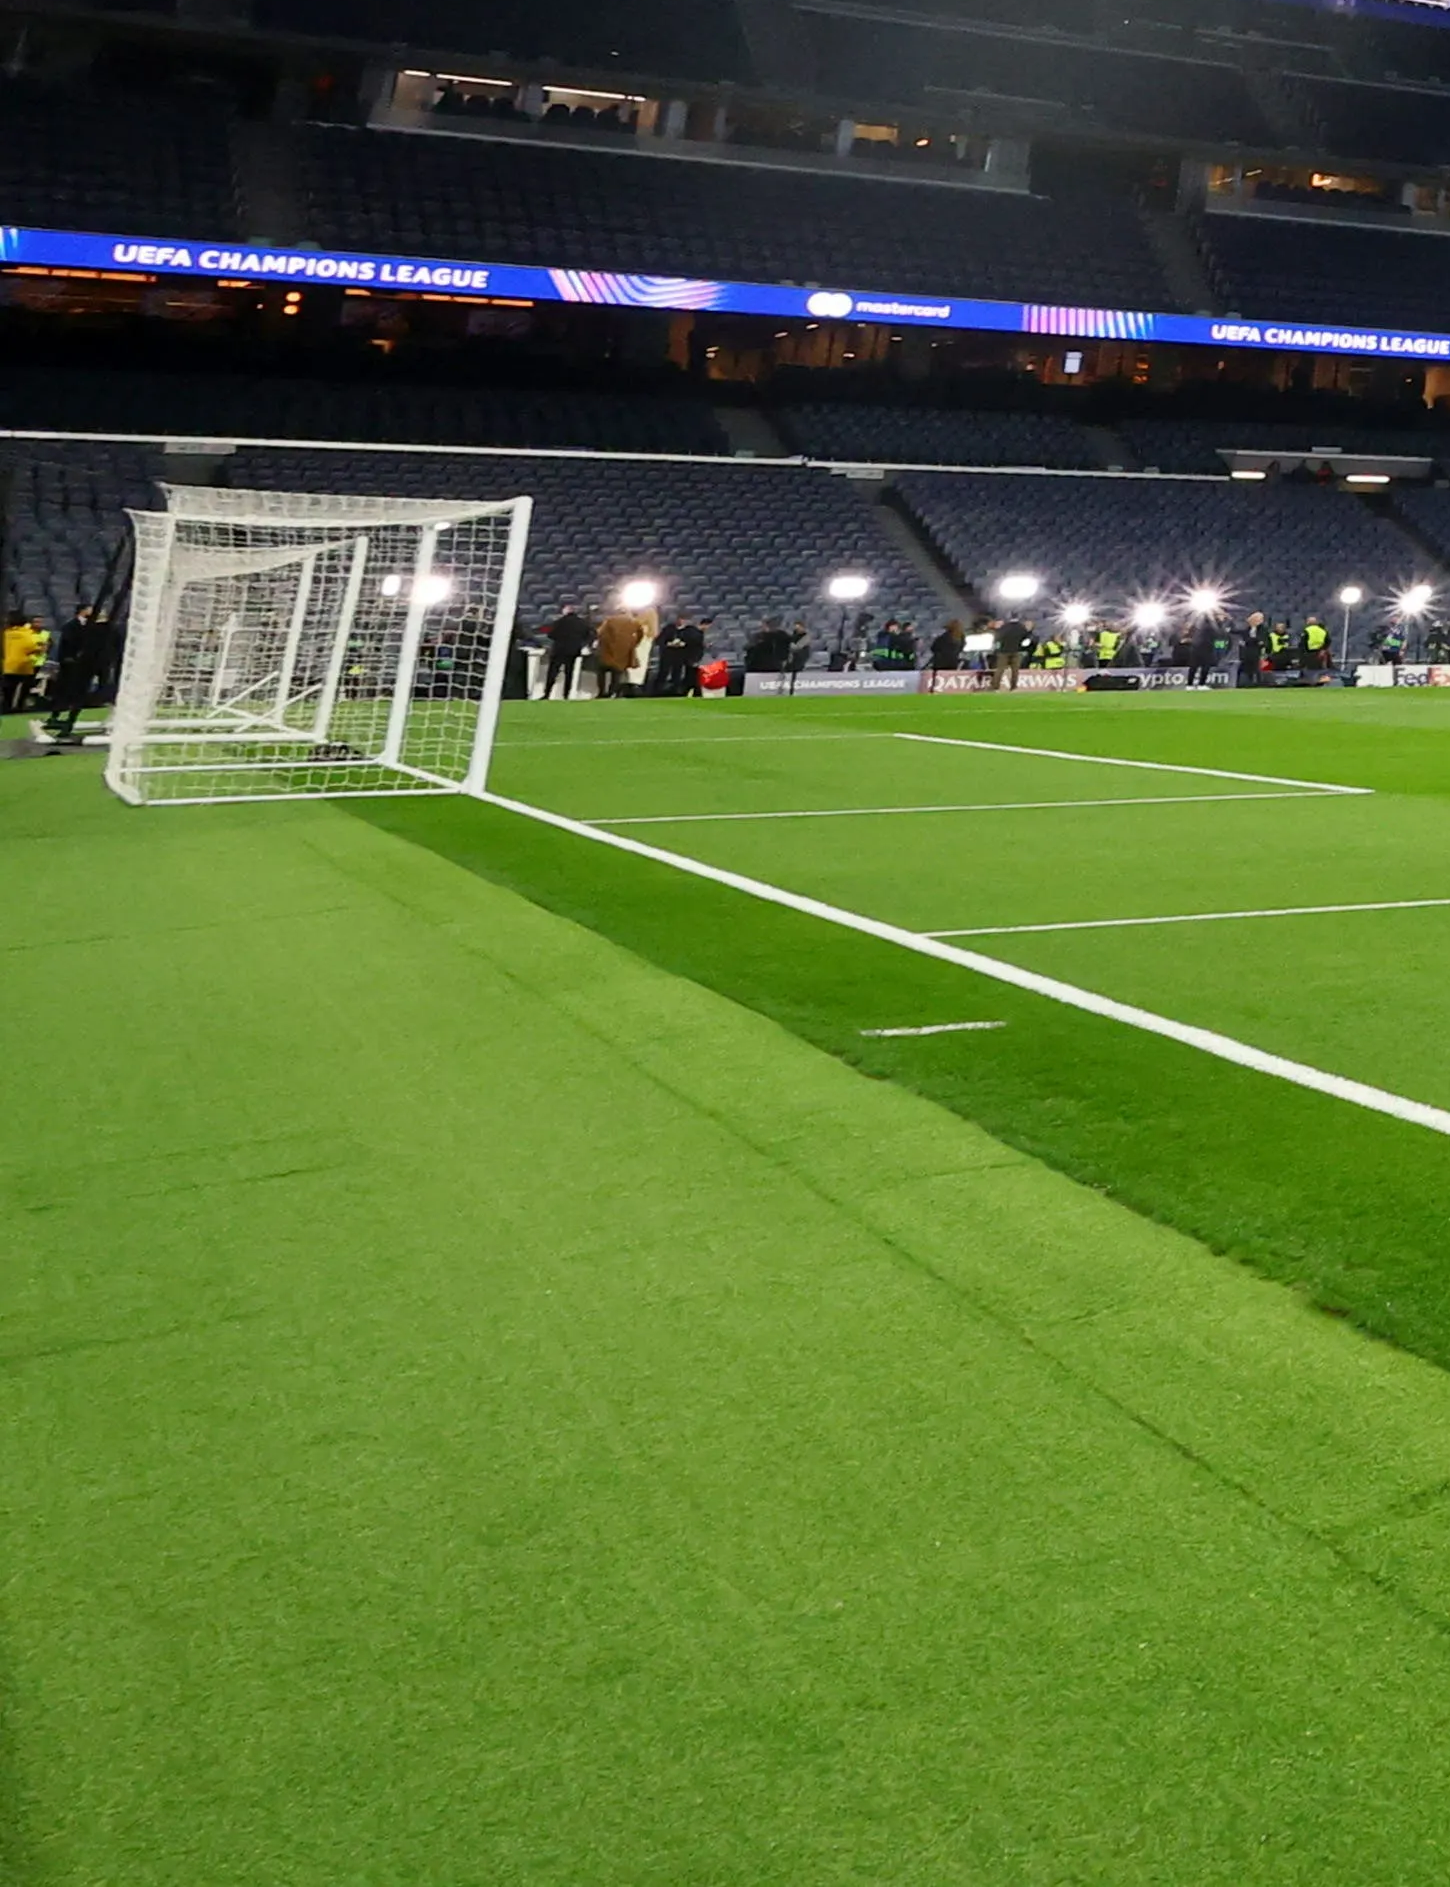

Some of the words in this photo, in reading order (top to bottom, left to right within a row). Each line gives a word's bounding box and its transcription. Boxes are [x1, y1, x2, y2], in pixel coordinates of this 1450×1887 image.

[113, 243, 191, 268] UEFA
[198, 250, 375, 282] CHAMPIONS
[379, 262, 489, 290] LEAGUE
[856, 301, 951, 318] mastercard
[1211, 323, 1261, 343] UEFA
[1264, 326, 1377, 353] CHAMPIONS
[1379, 335, 1450, 356] LEAGUE
[793, 680, 860, 690] CHAMPIONS
[863, 679, 906, 689] LEAGUE
[927, 674, 993, 692] QATAR
[1001, 673, 1077, 689] ARWAYS
